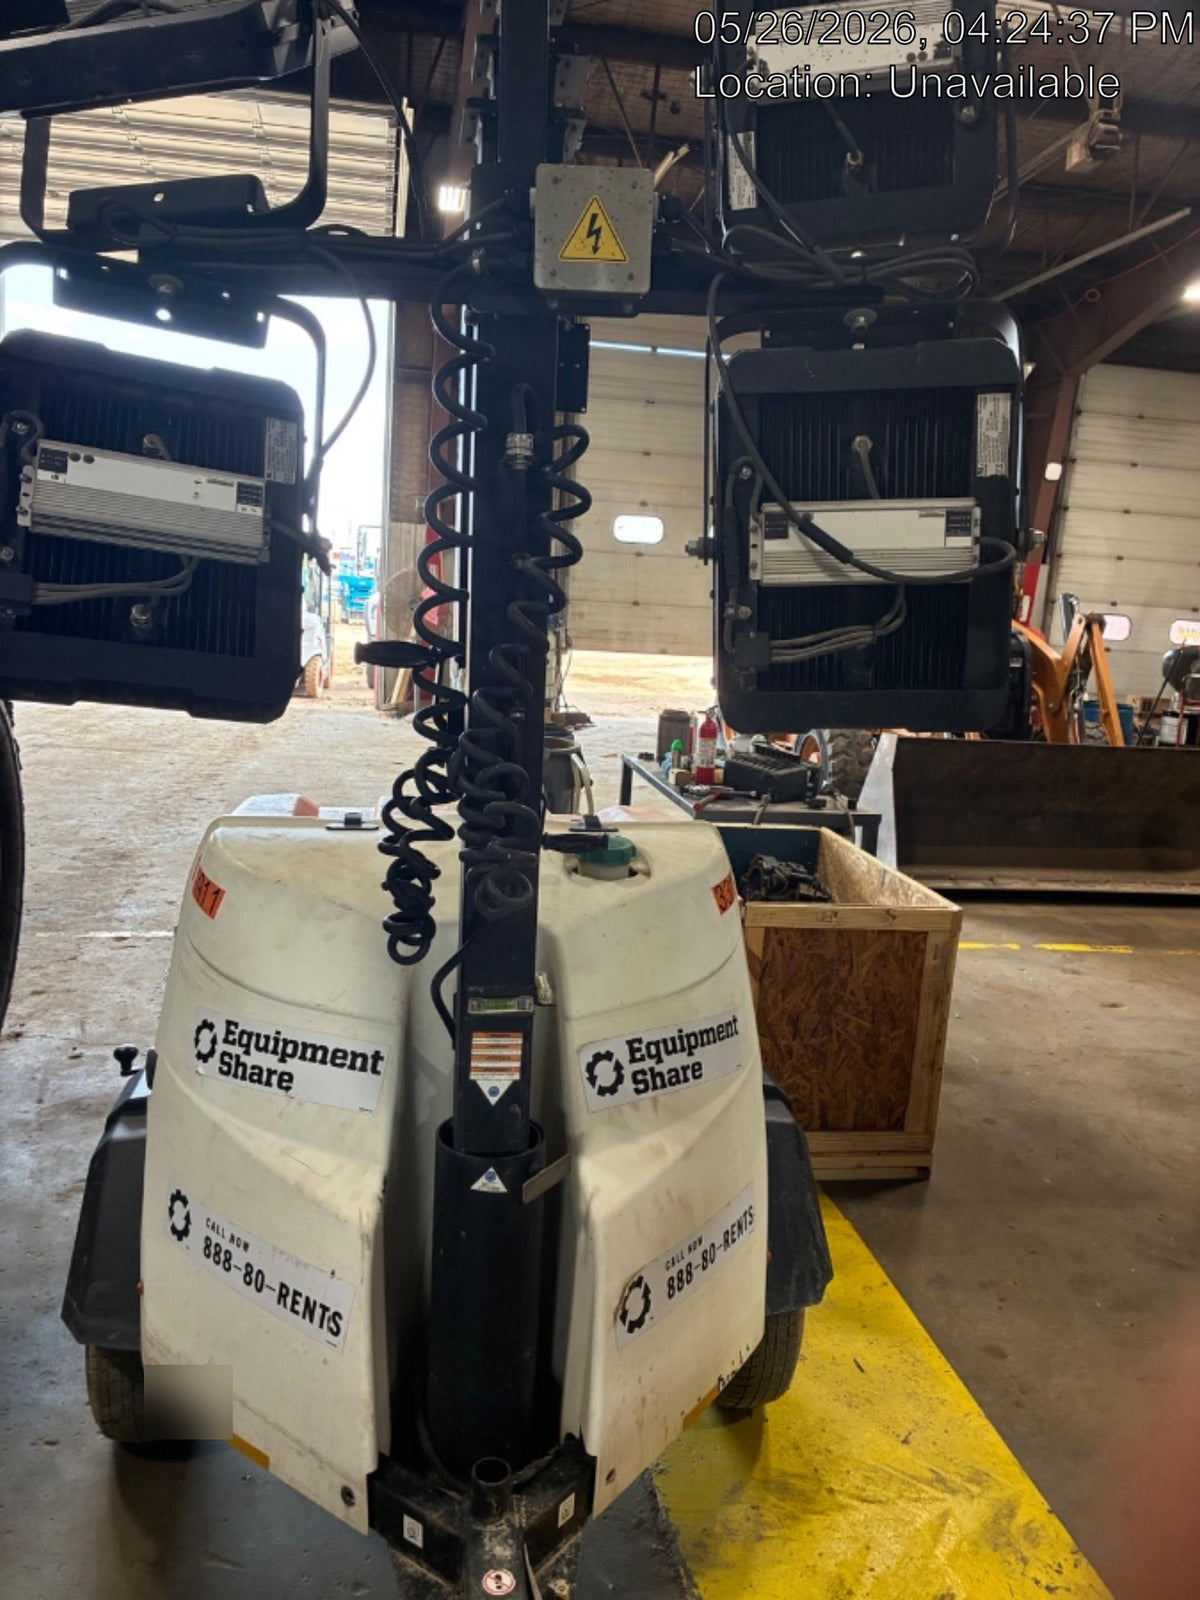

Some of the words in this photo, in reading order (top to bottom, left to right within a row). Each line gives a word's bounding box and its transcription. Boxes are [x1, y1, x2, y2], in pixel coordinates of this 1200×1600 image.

[222, 1019, 384, 1075] Equipment
[626, 1015, 739, 1065] Equipment
[218, 1050, 294, 1093] Share
[631, 1061, 703, 1095] Share
[205, 1217, 226, 1239] CALL
[229, 1233, 250, 1252] NOW
[665, 1252, 685, 1270] CALL
[688, 1235, 703, 1253] NOW
[666, 1205, 755, 1300] 888-80-RENTS
[202, 1235, 343, 1337] 888-80-RENTS
